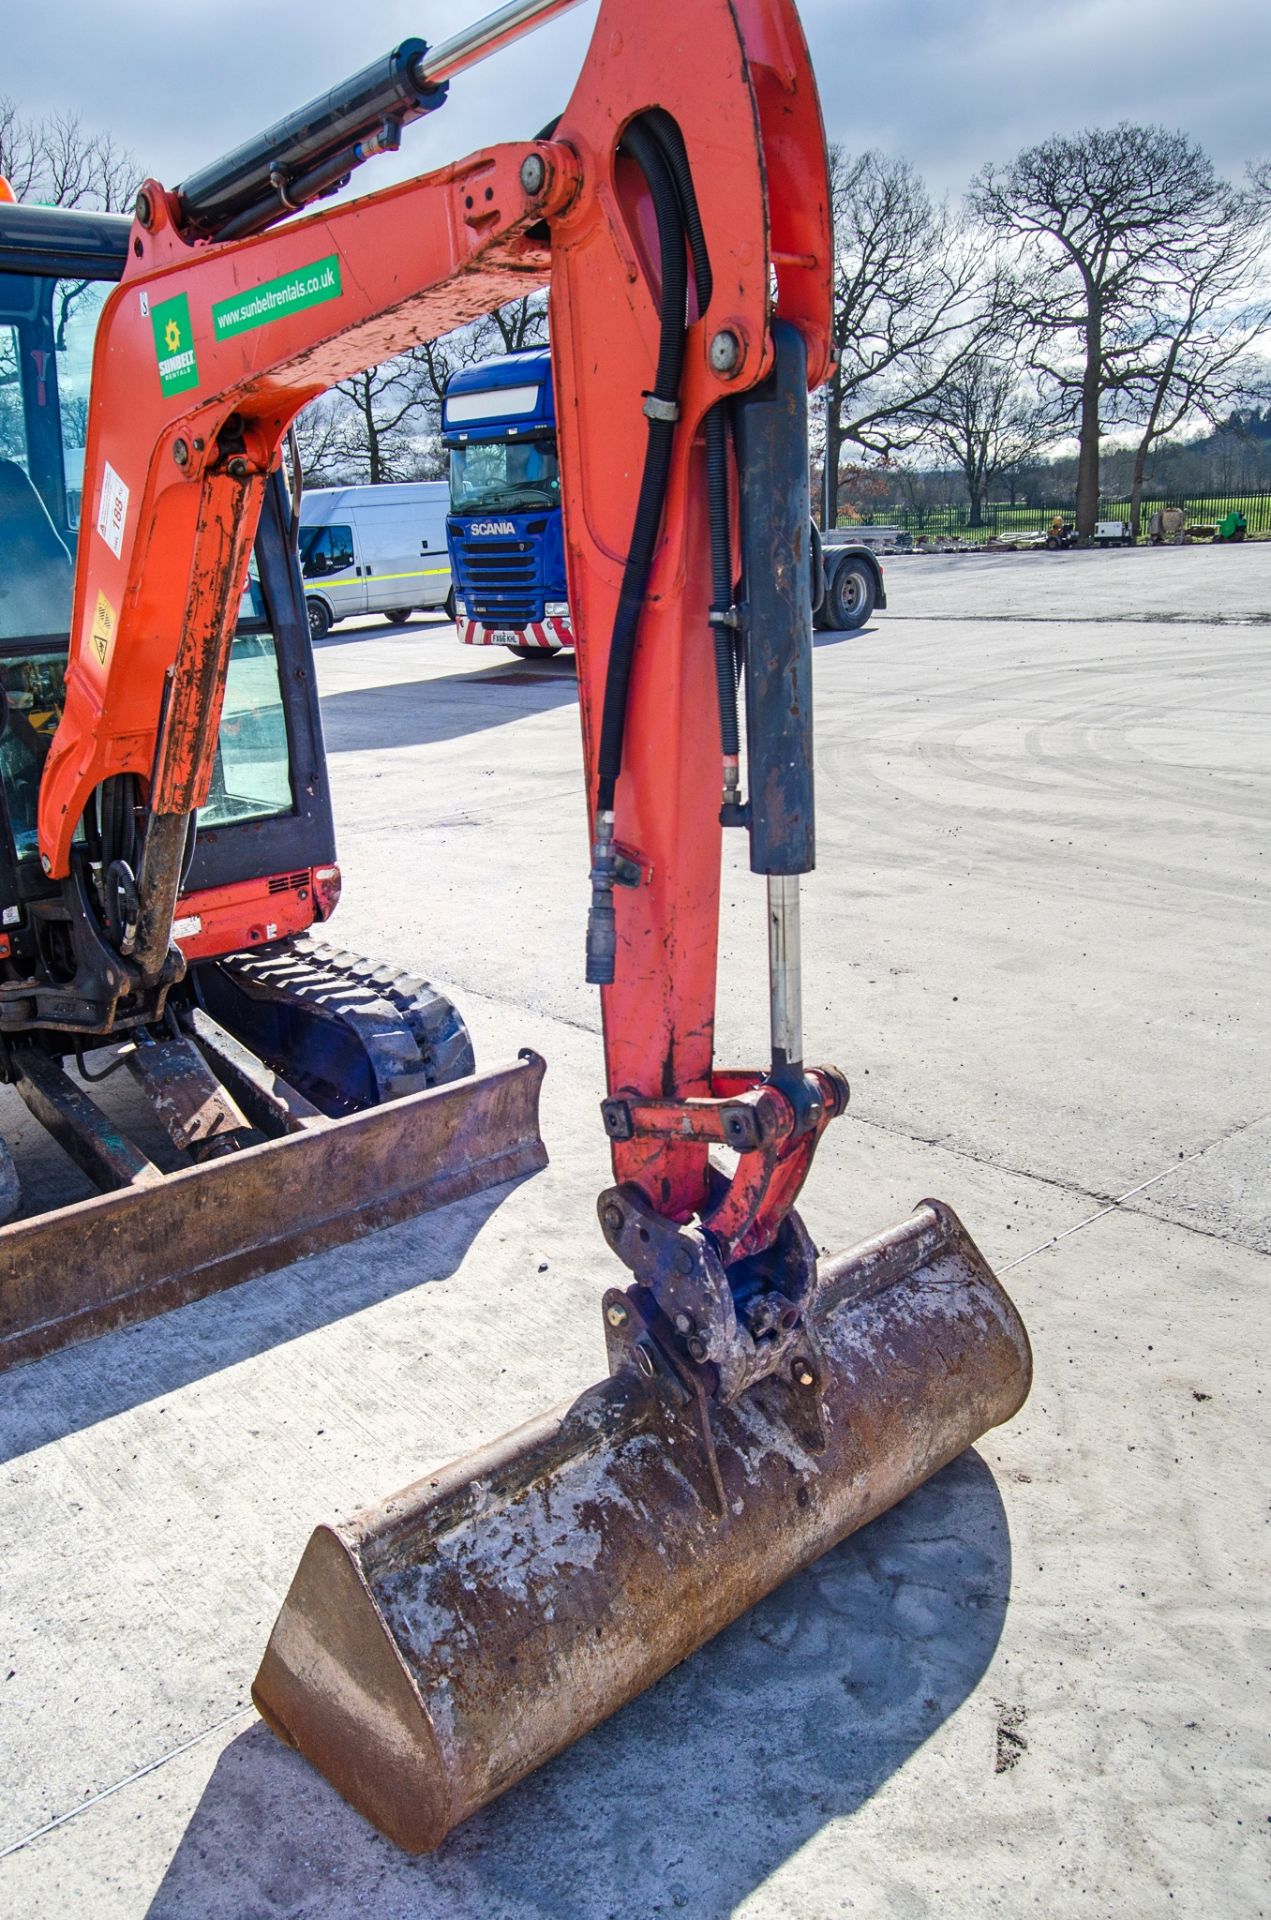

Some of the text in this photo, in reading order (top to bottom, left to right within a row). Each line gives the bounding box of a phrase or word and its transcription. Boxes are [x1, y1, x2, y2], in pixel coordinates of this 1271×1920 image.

[217, 267, 335, 328] www.sunbeltrentals.co.uk
[158, 349, 194, 376] SUNBELT
[165, 366, 191, 381] RENTALS
[112, 497, 123, 530] 188
[470, 522, 516, 536] SCANIA
